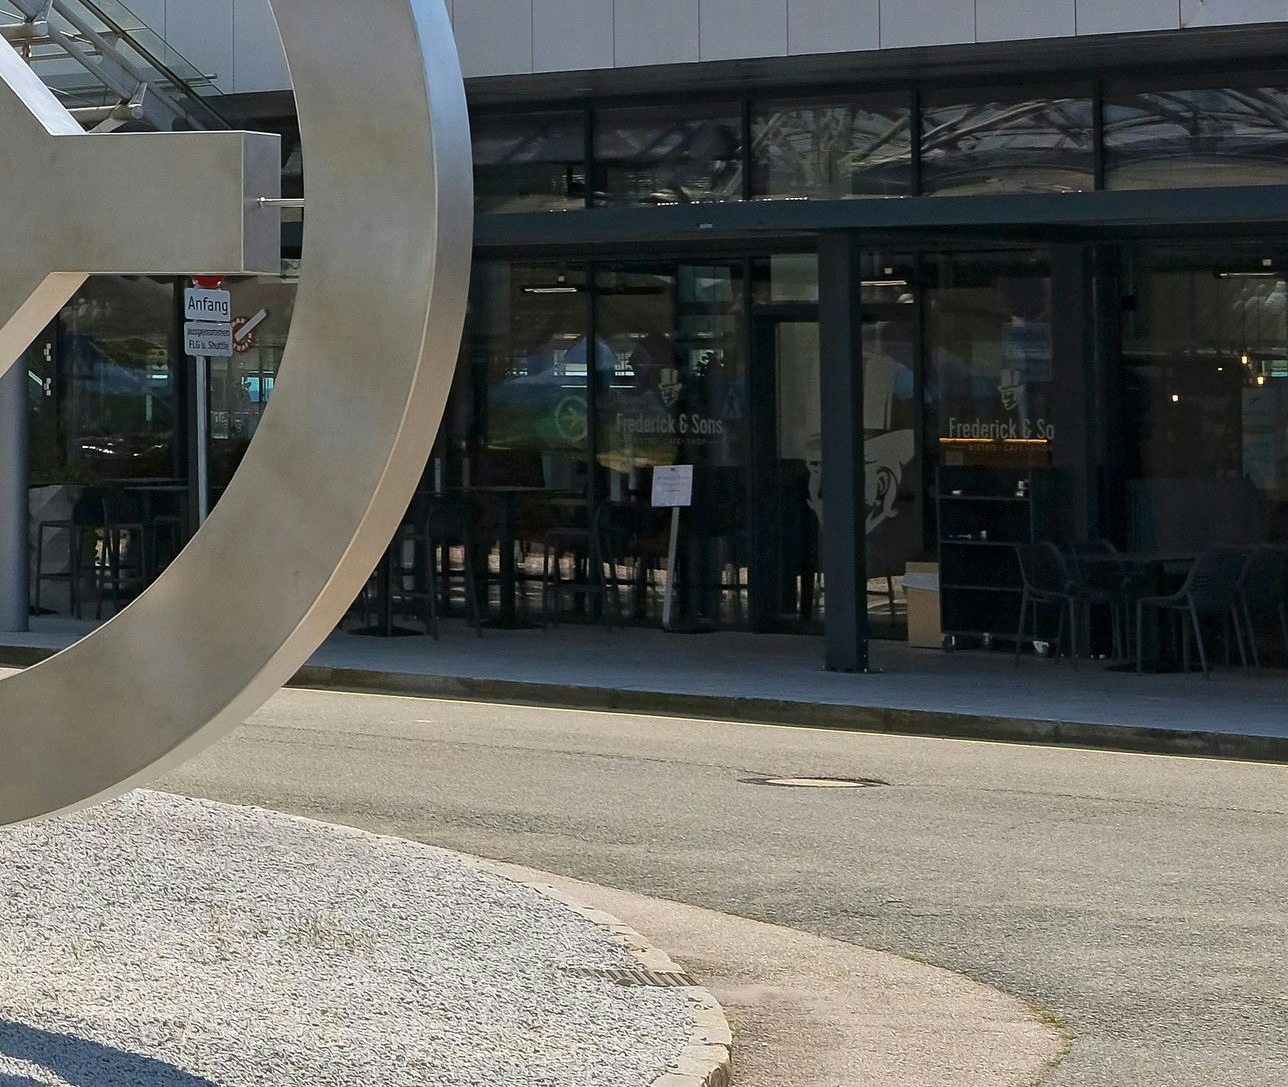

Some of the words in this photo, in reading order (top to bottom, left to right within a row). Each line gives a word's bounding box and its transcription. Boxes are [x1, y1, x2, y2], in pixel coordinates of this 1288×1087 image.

[188, 296, 228, 315] Anfang
[187, 328, 230, 337] ausgenommen
[616, 412, 675, 433] Frederick
[679, 413, 688, 433] &
[691, 413, 723, 434] Sons
[949, 417, 1017, 439] Frederick
[1022, 418, 1032, 439] &
[1036, 418, 1055, 440] So
